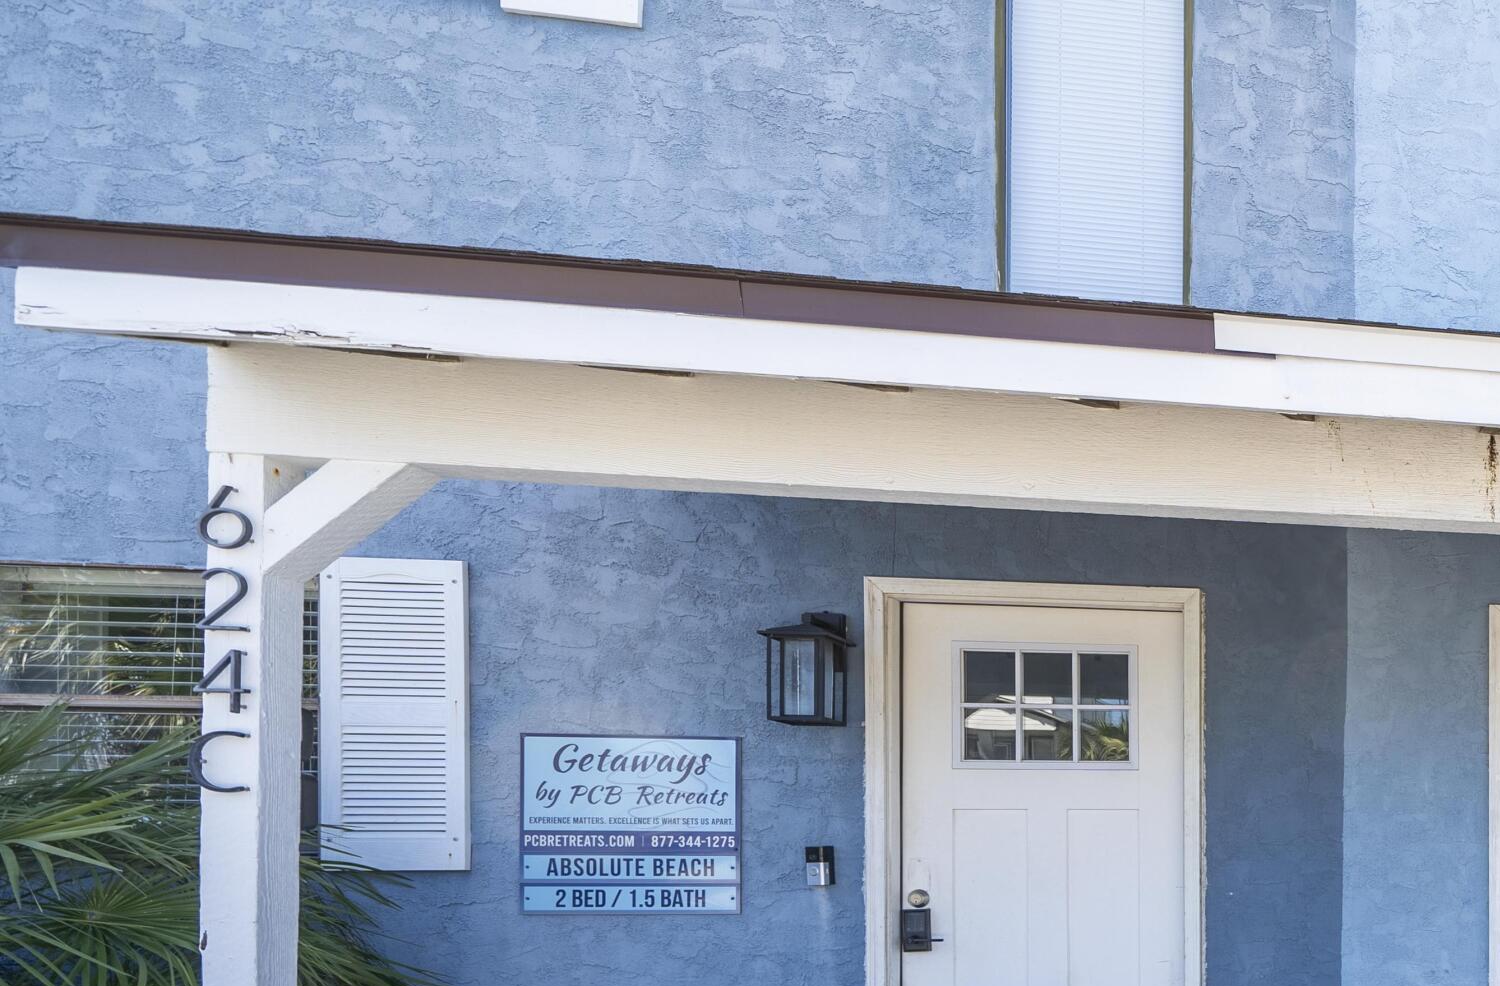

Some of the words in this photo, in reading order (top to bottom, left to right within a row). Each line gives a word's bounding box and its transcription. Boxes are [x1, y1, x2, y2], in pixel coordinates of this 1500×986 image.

[189, 485, 254, 793] 624C
[553, 743, 713, 785] Getaways
[535, 780, 562, 809] by
[569, 784, 623, 805] PCB
[636, 785, 729, 807] Retreats
[529, 816, 571, 825] EXPERIENCE
[572, 816, 607, 825] MATTERS.
[608, 817, 651, 825] EXCELLENCE
[652, 817, 660, 825] IS
[661, 817, 681, 825] WHAT
[682, 817, 699, 826] SETS
[700, 818, 710, 826] US
[711, 818, 734, 826] APART.
[524, 834, 635, 848] PCBRETREATS.COM
[651, 835, 736, 848] 877-344-1275
[547, 857, 646, 877] ABSOLUTE
[653, 858, 715, 877] BEACH
[555, 889, 567, 907] 2
[572, 889, 607, 907] BED
[611, 889, 622, 908] /
[629, 889, 655, 908] 1.5
[661, 889, 707, 908] BATH
